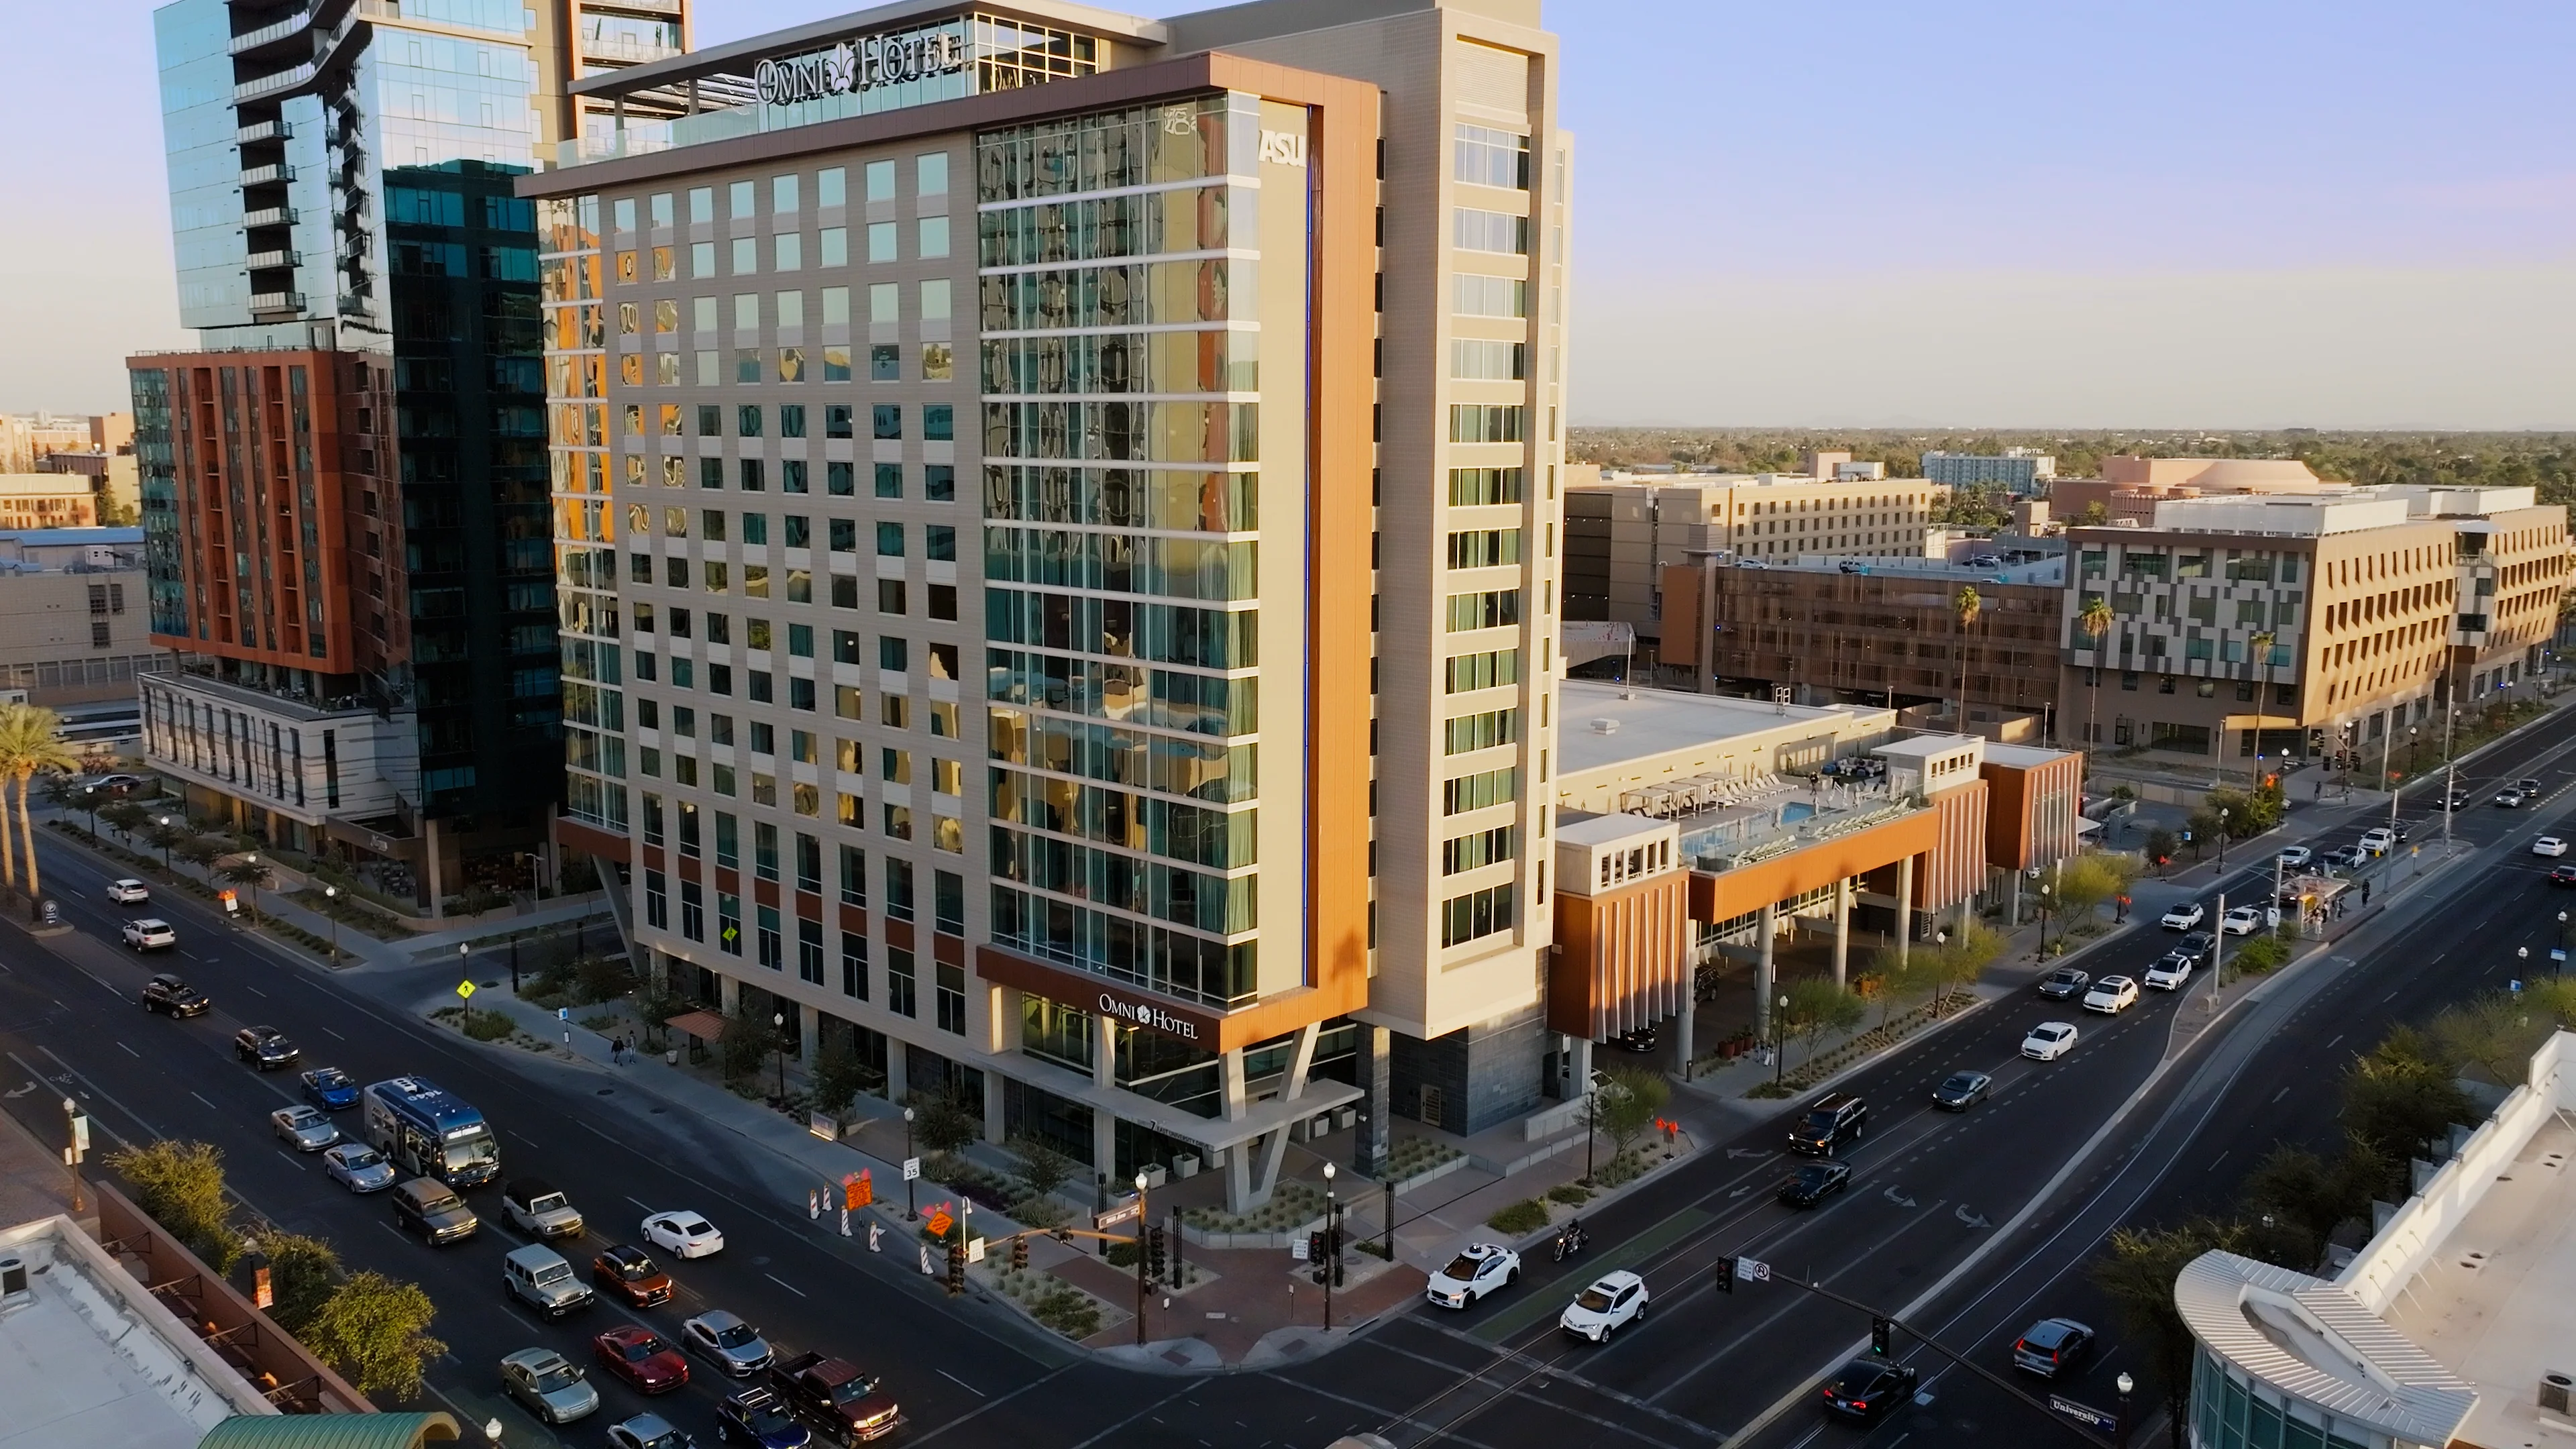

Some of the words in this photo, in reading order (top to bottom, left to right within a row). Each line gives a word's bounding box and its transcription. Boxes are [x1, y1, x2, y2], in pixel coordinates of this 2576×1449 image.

[755, 58, 829, 105] OMNI
[857, 31, 963, 85] HOTEL
[1258, 129, 1307, 168] ASU
[1099, 994, 1135, 1020] OMNI
[1152, 1008, 1198, 1040] HOTEL
[1150, 1119, 1157, 1130] 7
[1157, 1126, 1169, 1136] EAST
[1169, 1130, 1195, 1144] UNIVERSITY
[907, 1168, 918, 1177] 35
[2053, 1400, 2100, 1425] University
